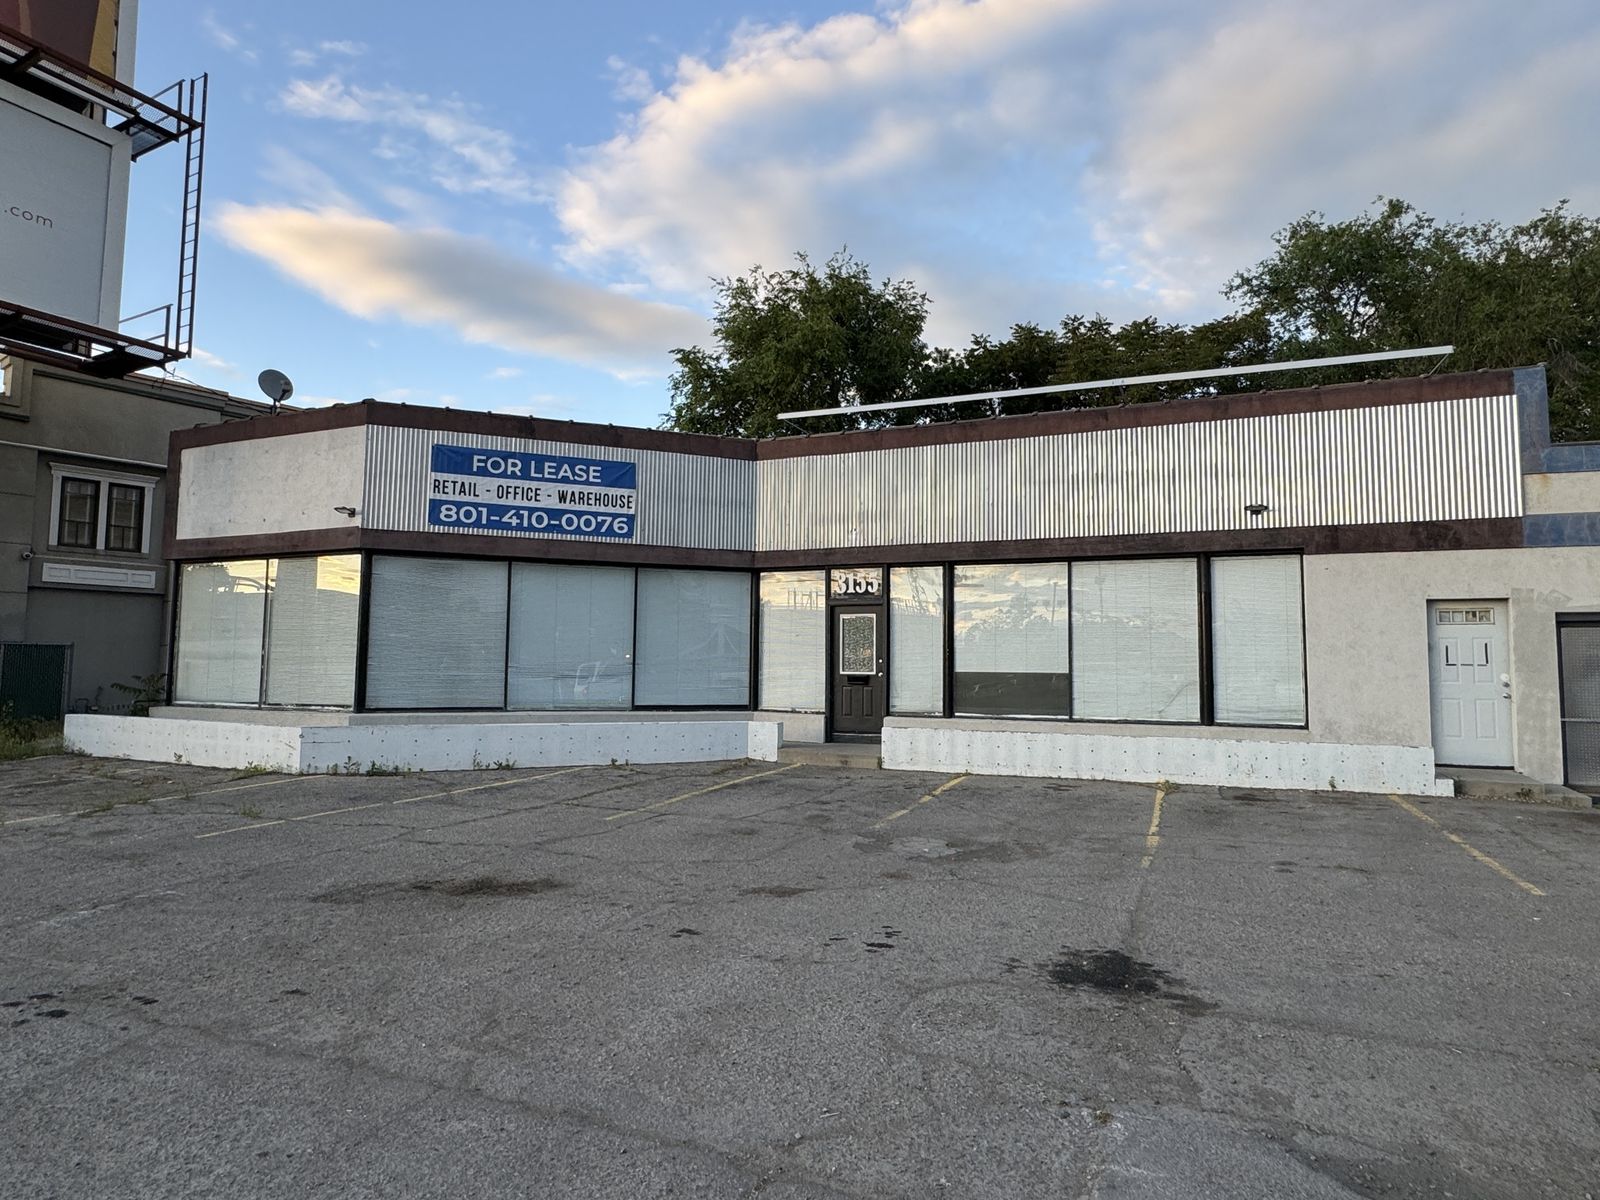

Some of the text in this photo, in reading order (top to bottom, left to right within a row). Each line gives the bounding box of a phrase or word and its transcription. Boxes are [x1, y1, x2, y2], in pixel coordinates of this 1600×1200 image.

[4, 206, 53, 229] .com
[472, 455, 602, 483] FOR LEASE
[432, 479, 480, 498] RETAIL
[496, 484, 542, 502] OFFICE
[557, 489, 634, 510] WAREHOUSE
[439, 504, 629, 534] 801-410-0076
[836, 571, 879, 594] 3155
